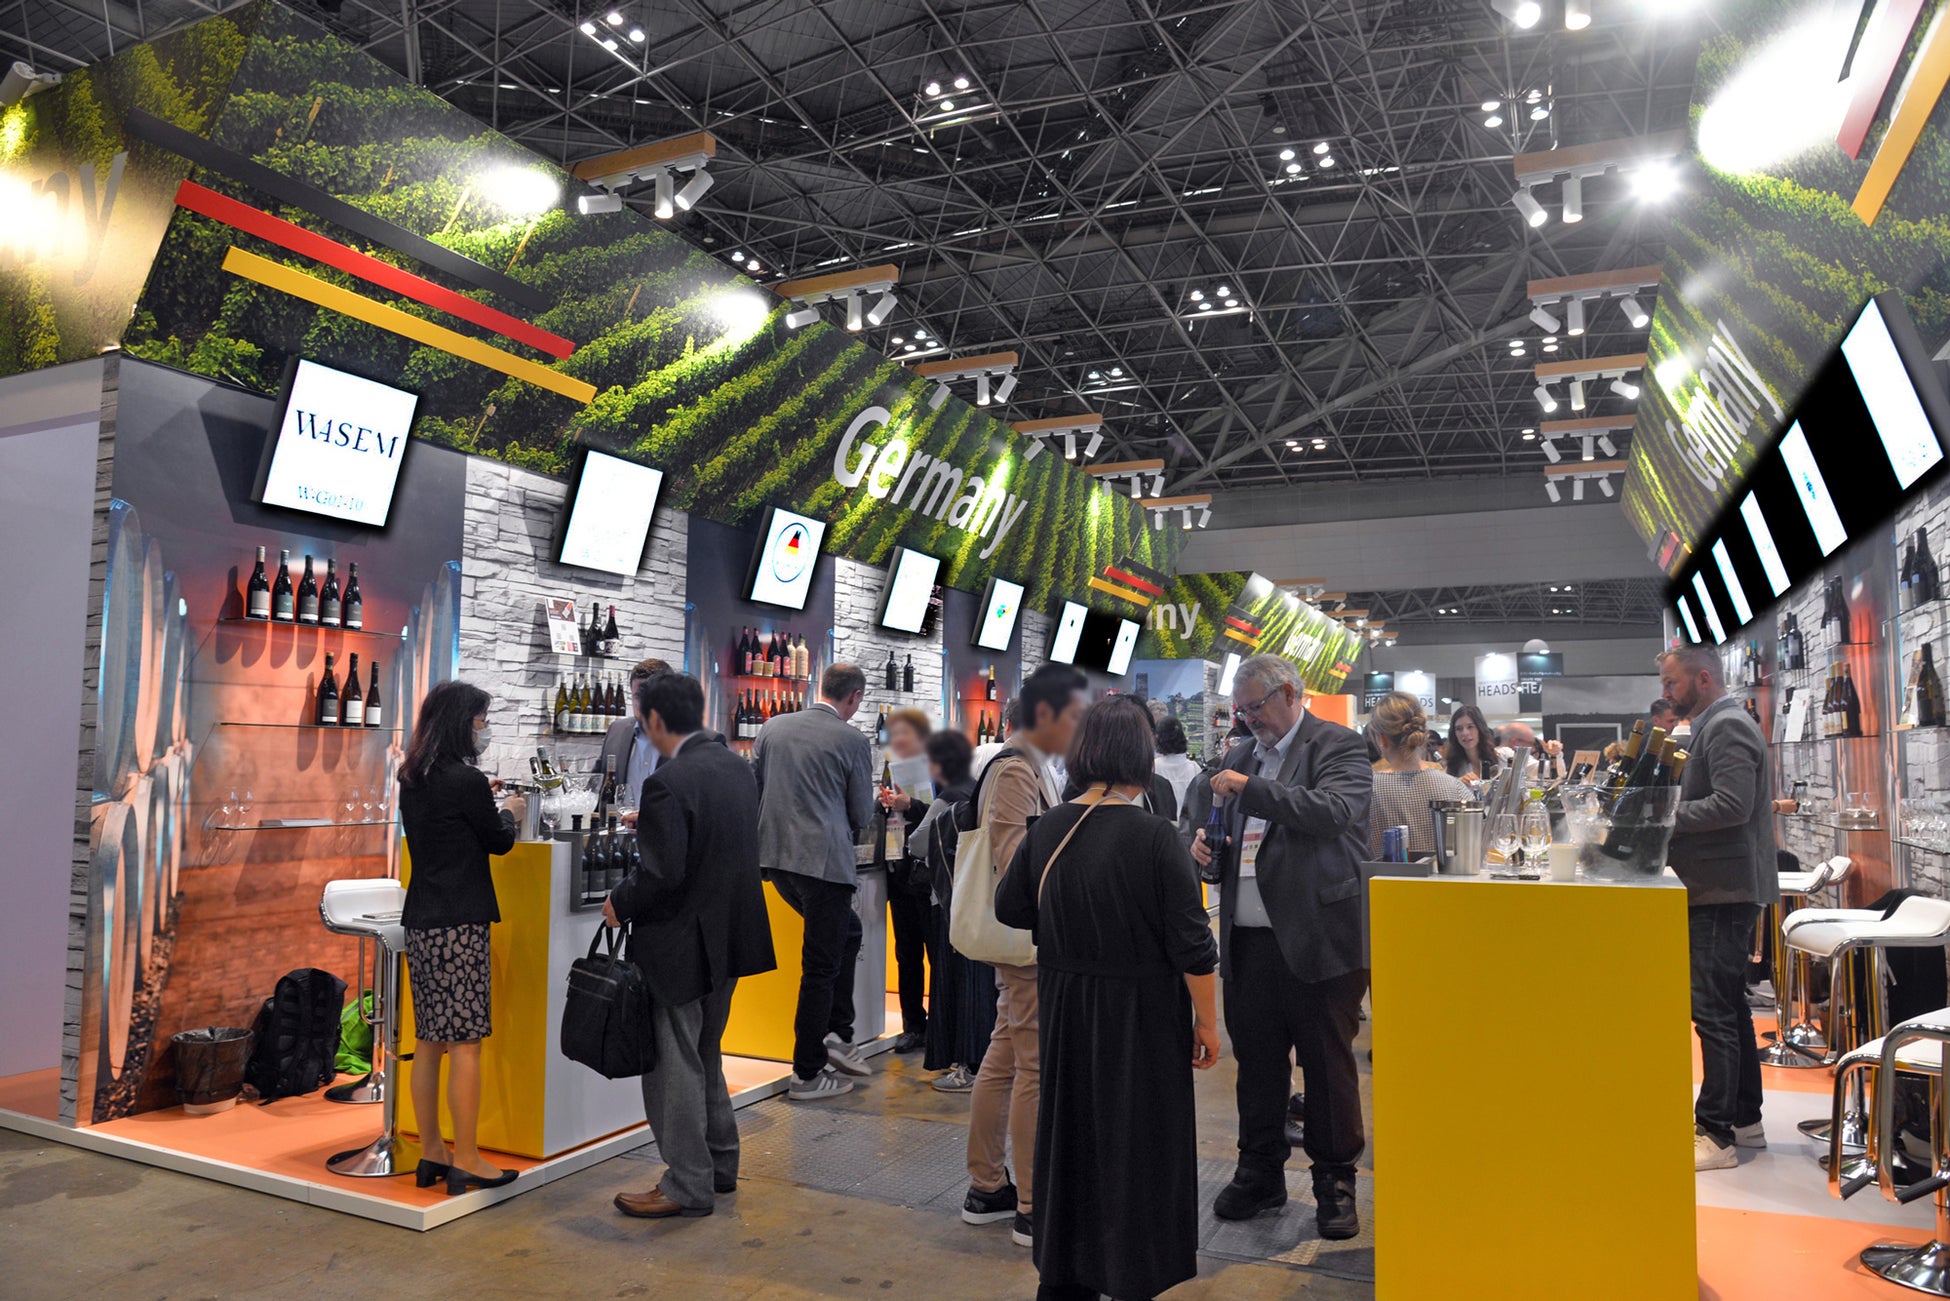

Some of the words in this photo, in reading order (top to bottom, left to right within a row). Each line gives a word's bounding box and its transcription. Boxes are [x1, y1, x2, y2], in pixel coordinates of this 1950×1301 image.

[296, 409, 399, 459] WASEM
[1665, 318, 1786, 492] Germany
[833, 405, 1028, 560] Germany
[1478, 683, 1516, 697] HEADS
